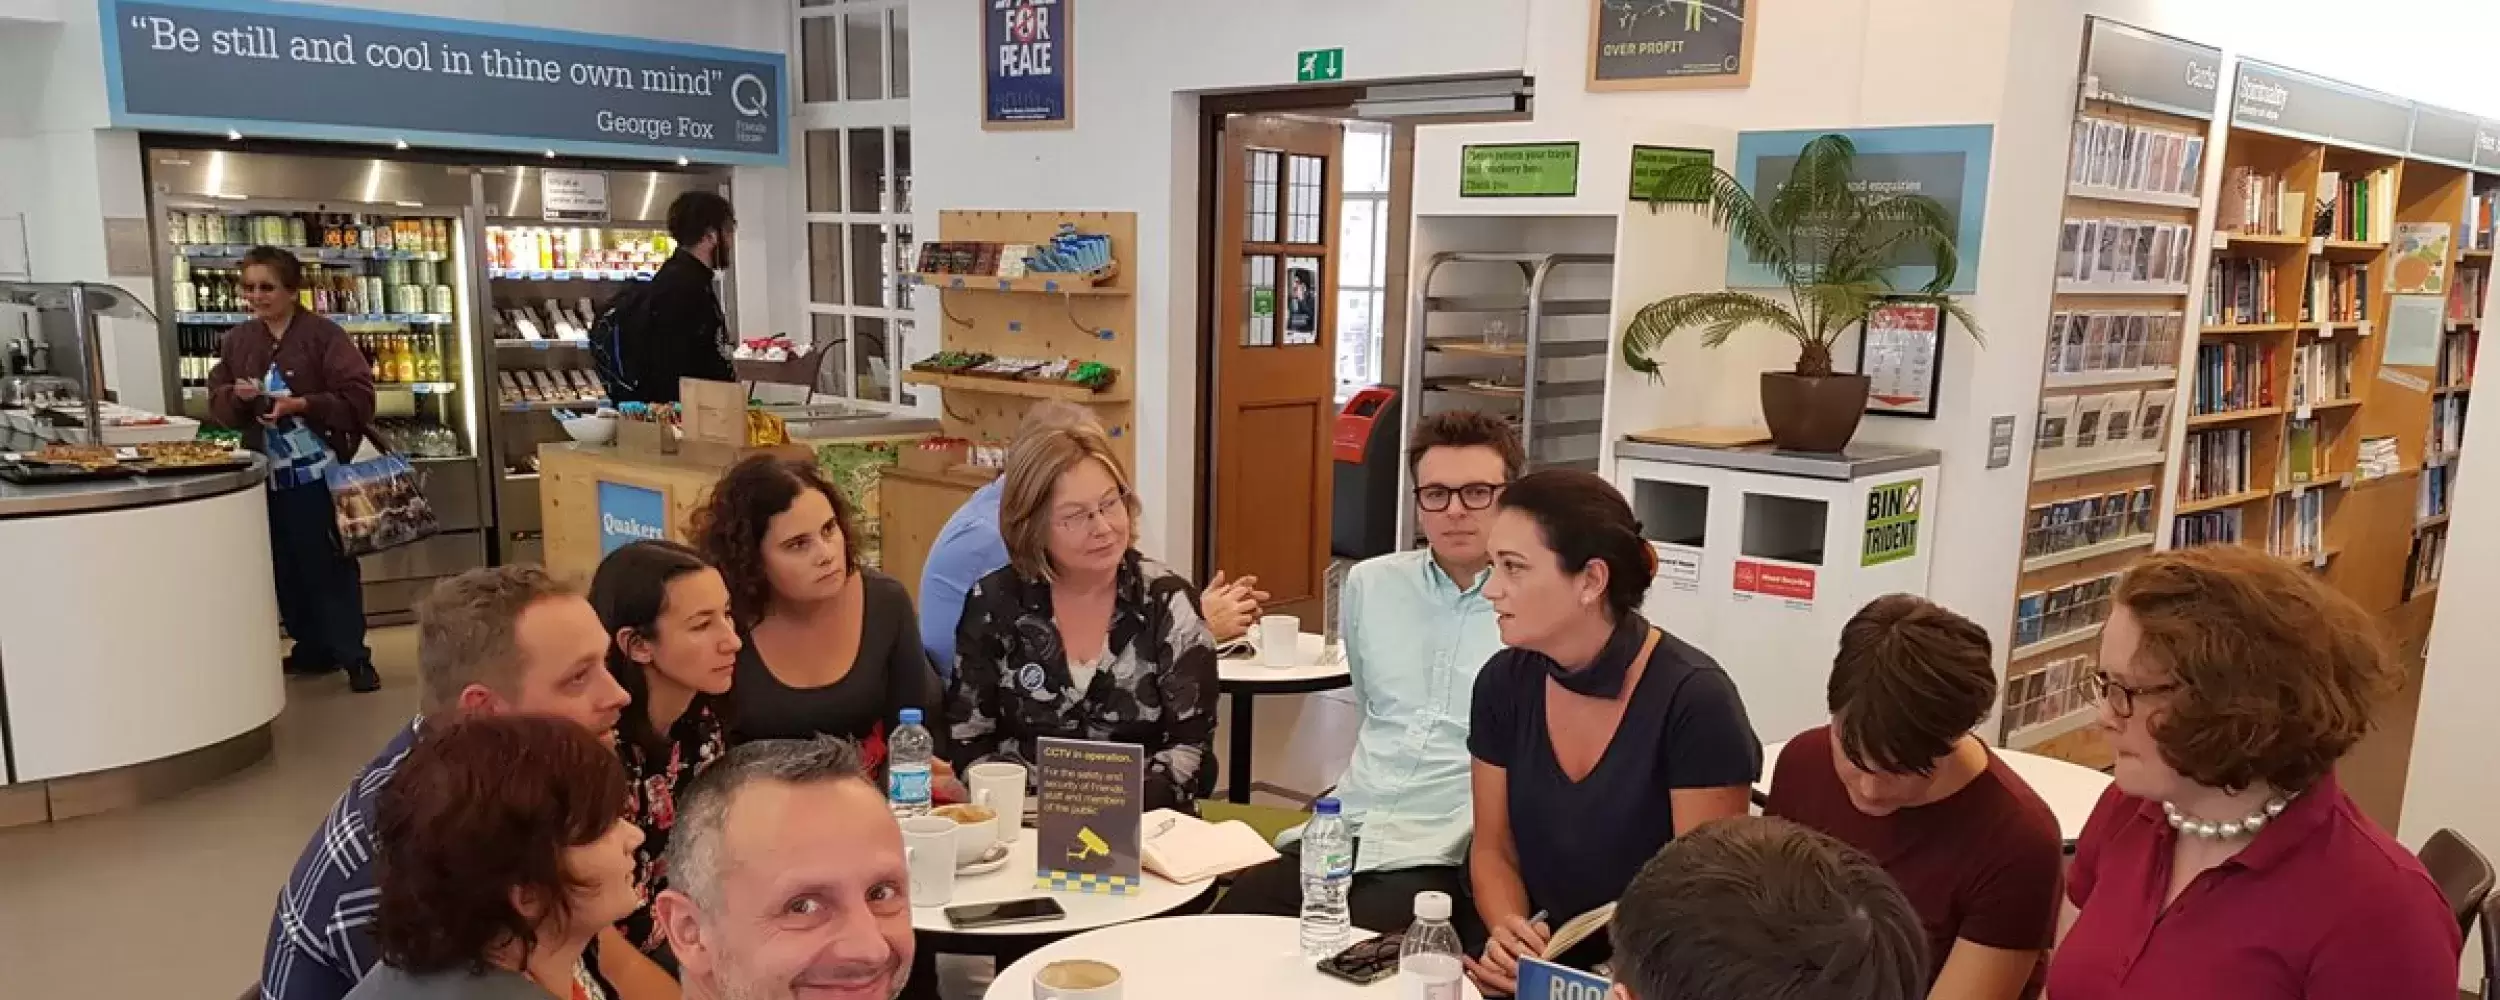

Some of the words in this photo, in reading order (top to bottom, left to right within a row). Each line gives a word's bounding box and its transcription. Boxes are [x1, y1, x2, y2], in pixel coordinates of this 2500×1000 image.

[1004, 7, 1050, 42] FOR
[131, 16, 200, 52] “Be
[211, 26, 280, 60] still
[290, 34, 357, 66] and
[366, 41, 432, 72] cool
[441, 44, 473, 75] in
[481, 49, 561, 83] thine
[570, 62, 634, 91] own
[641, 66, 723, 97] mind”
[999, 42, 1052, 77] PEACE
[1603, 43, 1636, 57] OVER
[1639, 40, 1685, 55] PROFIT
[597, 110, 672, 141] George
[677, 115, 715, 140] Fox
[1868, 487, 1902, 520] BIN
[602, 512, 665, 541] Quakers
[1866, 520, 1917, 555] TRIDENT
[1044, 747, 1072, 759] CCTV
[1073, 750, 1082, 759] in
[1084, 752, 1133, 763] operation.
[1044, 766, 1059, 776] For
[1060, 768, 1076, 777] the
[1077, 771, 1103, 781] safety
[1105, 772, 1124, 782] and
[1044, 780, 1078, 791] security
[1080, 781, 1090, 790] of
[1044, 802, 1054, 813] of
[1055, 804, 1070, 813] the
[1064, 793, 1082, 803] and
[1083, 796, 1126, 805] members
